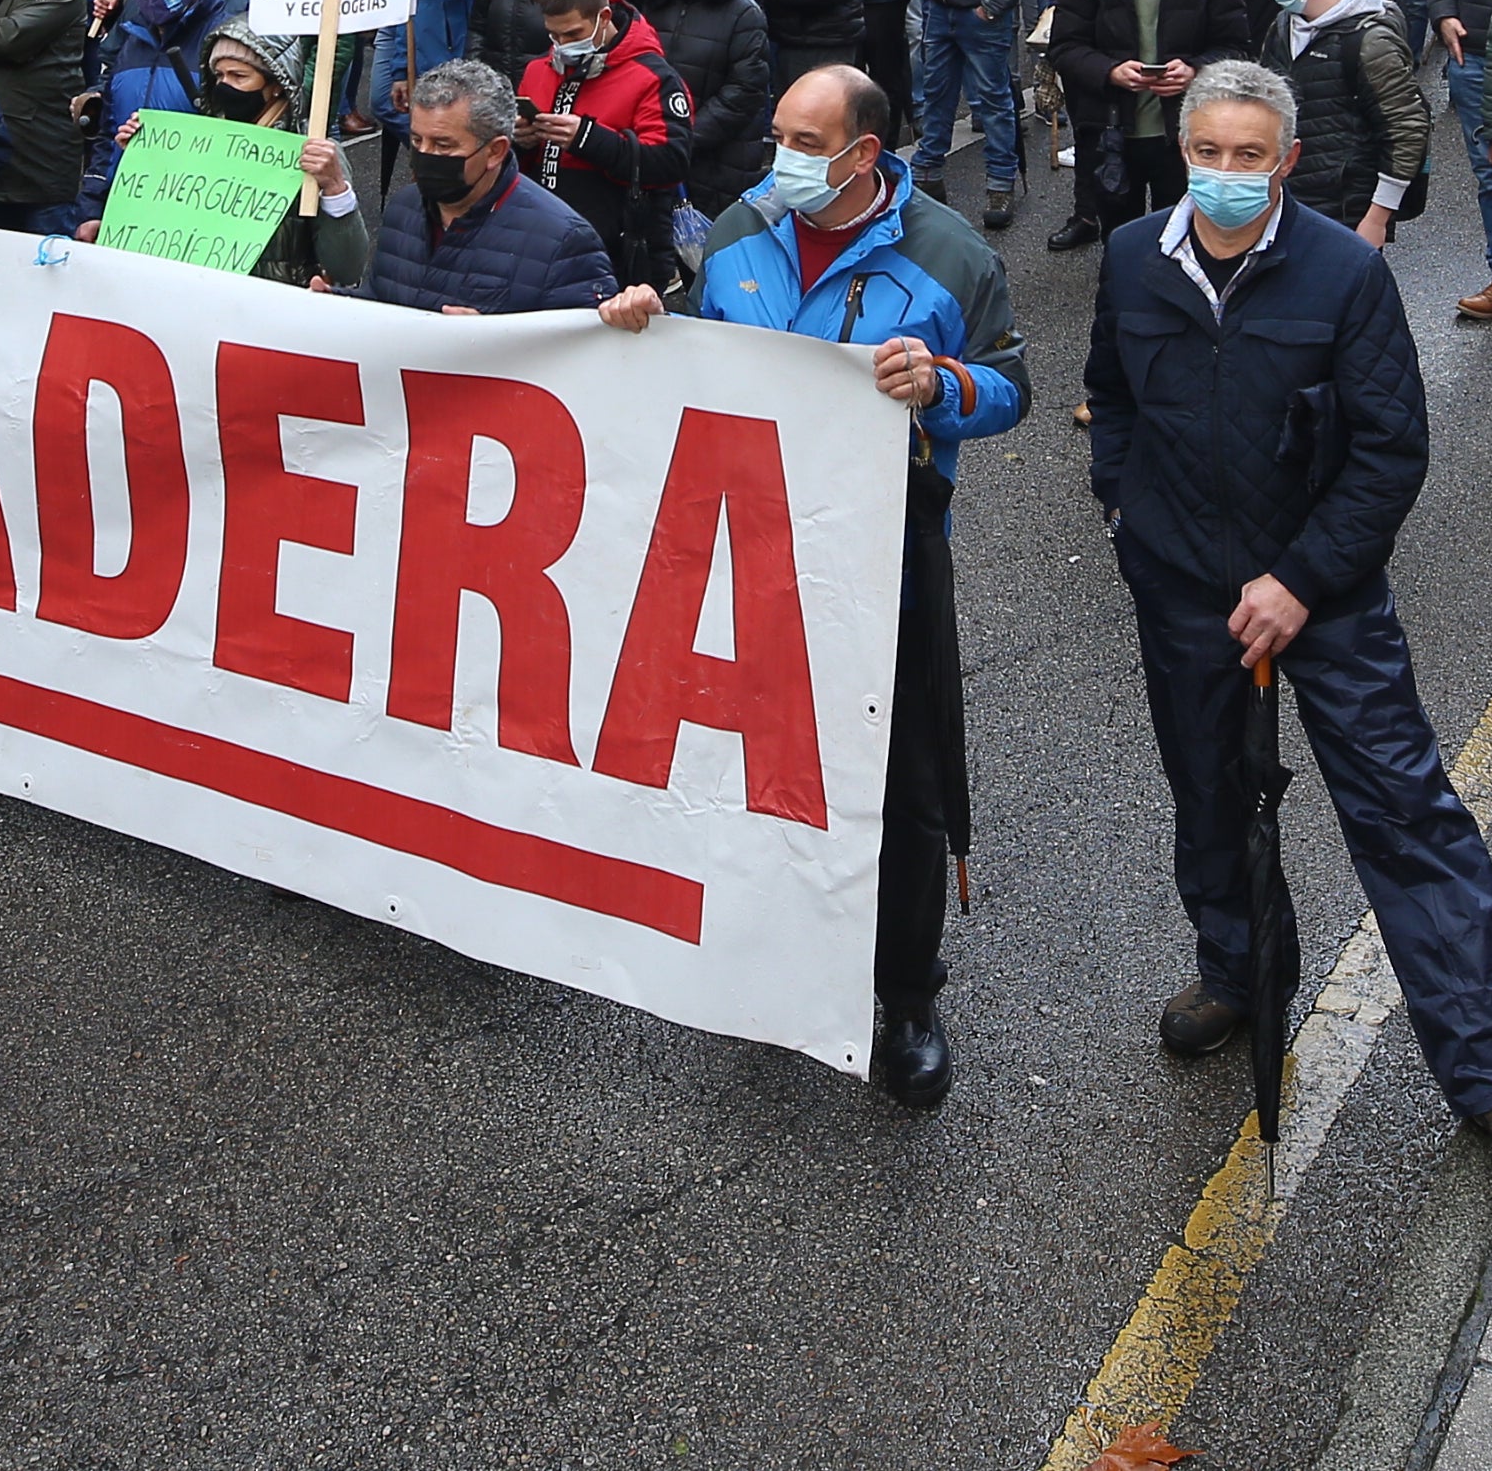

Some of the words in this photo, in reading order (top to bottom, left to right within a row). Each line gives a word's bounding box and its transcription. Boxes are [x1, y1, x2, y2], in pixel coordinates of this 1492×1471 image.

[285, 2, 295, 17] Y
[133, 122, 181, 151] AMO
[113, 171, 149, 199] ME
